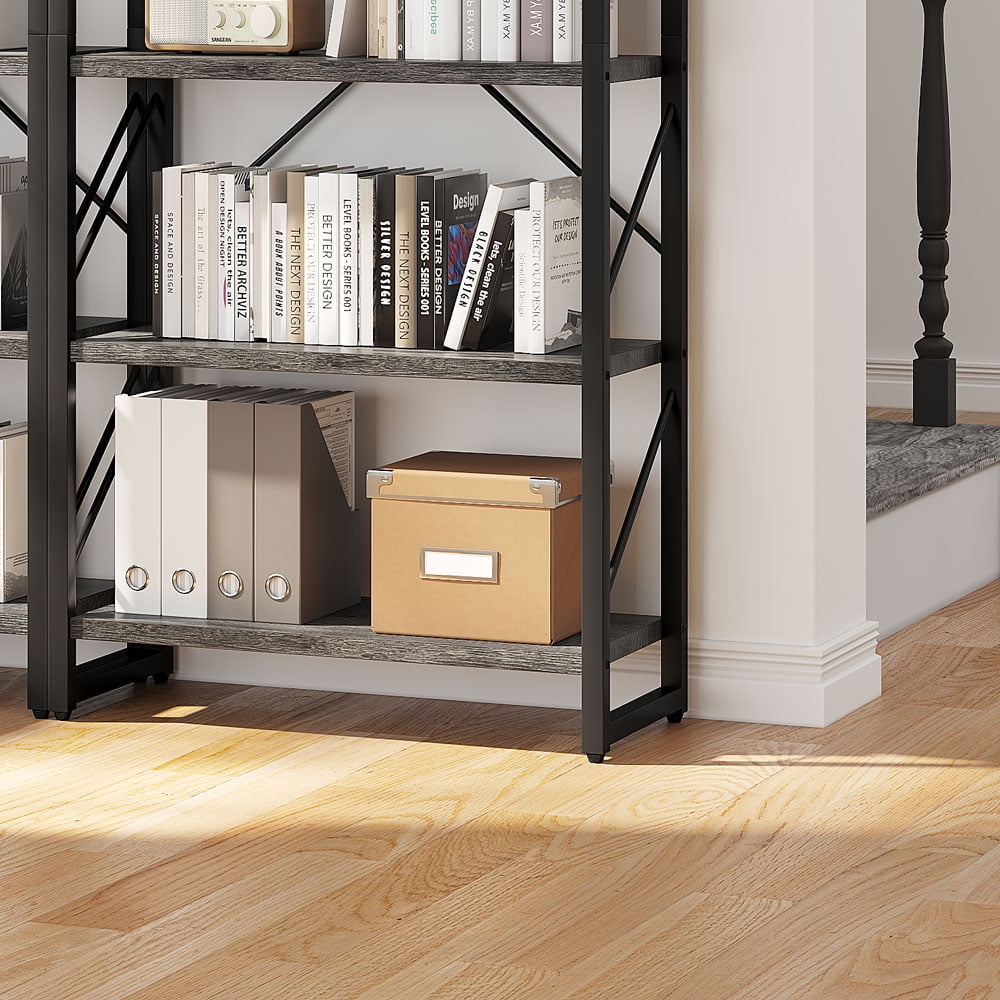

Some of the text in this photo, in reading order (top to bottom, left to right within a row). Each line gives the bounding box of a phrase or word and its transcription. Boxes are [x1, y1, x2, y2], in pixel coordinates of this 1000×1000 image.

[420, 201, 429, 228] LEVEL
[452, 192, 479, 211] Design
[275, 238, 283, 259] BOOK
[420, 229, 429, 261] BOOKS
[237, 226, 247, 318] BETTER ARCHVIZ
[275, 262, 283, 287] ABOUT
[322, 215, 333, 310] BETTER DESIGN
[380, 220, 391, 305] SILVER DESIGN
[458, 231, 488, 307] BLACK DESIGN
[482, 263, 496, 288] clean
[290, 228, 301, 336] THE NEXT DESIGN
[399, 231, 410, 340] THE NEXT DESIGN
[420, 267, 429, 298] SERIES
[275, 289, 283, 317] POINTS
[420, 299, 429, 315] 001
[477, 289, 488, 306] the
[473, 306, 484, 321] air
